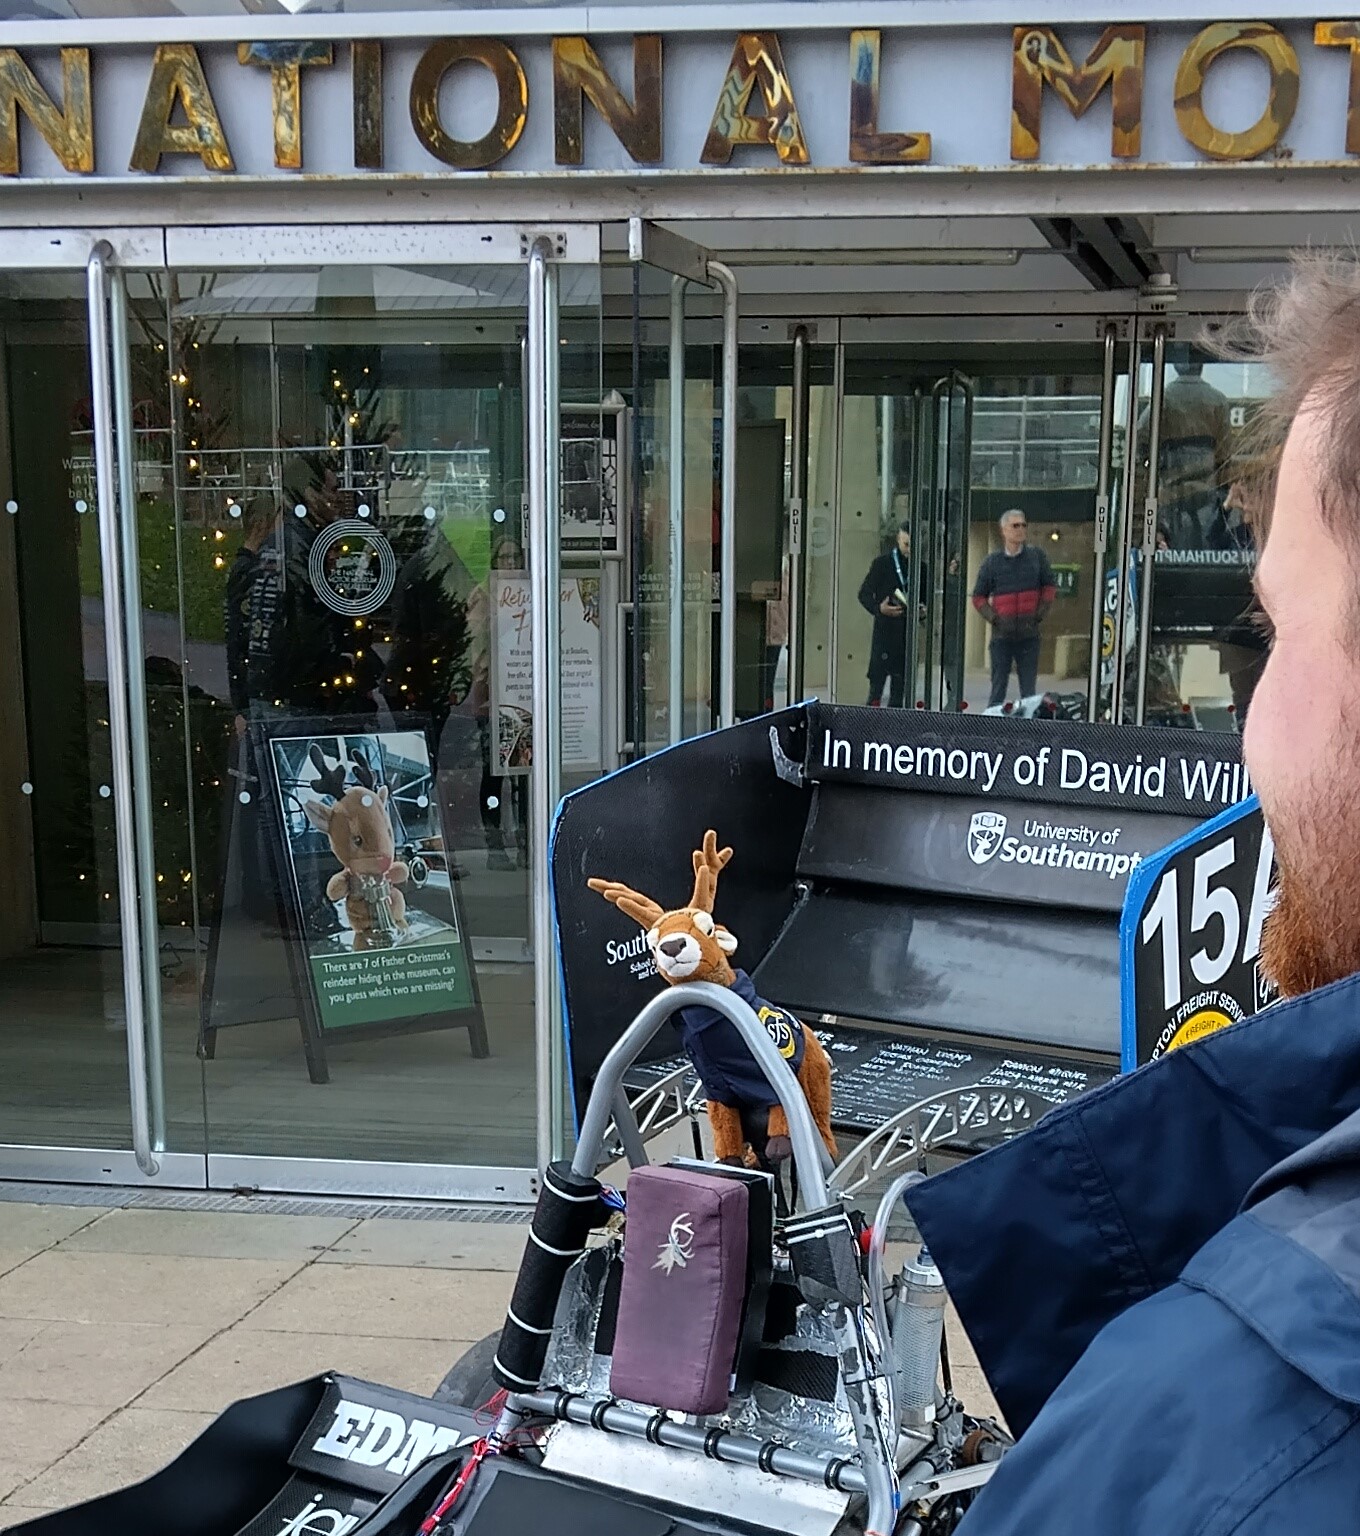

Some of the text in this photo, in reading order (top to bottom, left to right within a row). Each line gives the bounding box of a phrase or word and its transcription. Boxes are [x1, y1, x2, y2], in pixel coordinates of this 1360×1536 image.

[823, 729, 1256, 804] In memory of David Will
[1023, 819, 1121, 845] University of
[322, 961, 348, 973] There
[1176, 990, 1220, 1025] FREIGHT
[312, 1399, 480, 1477] EDM
